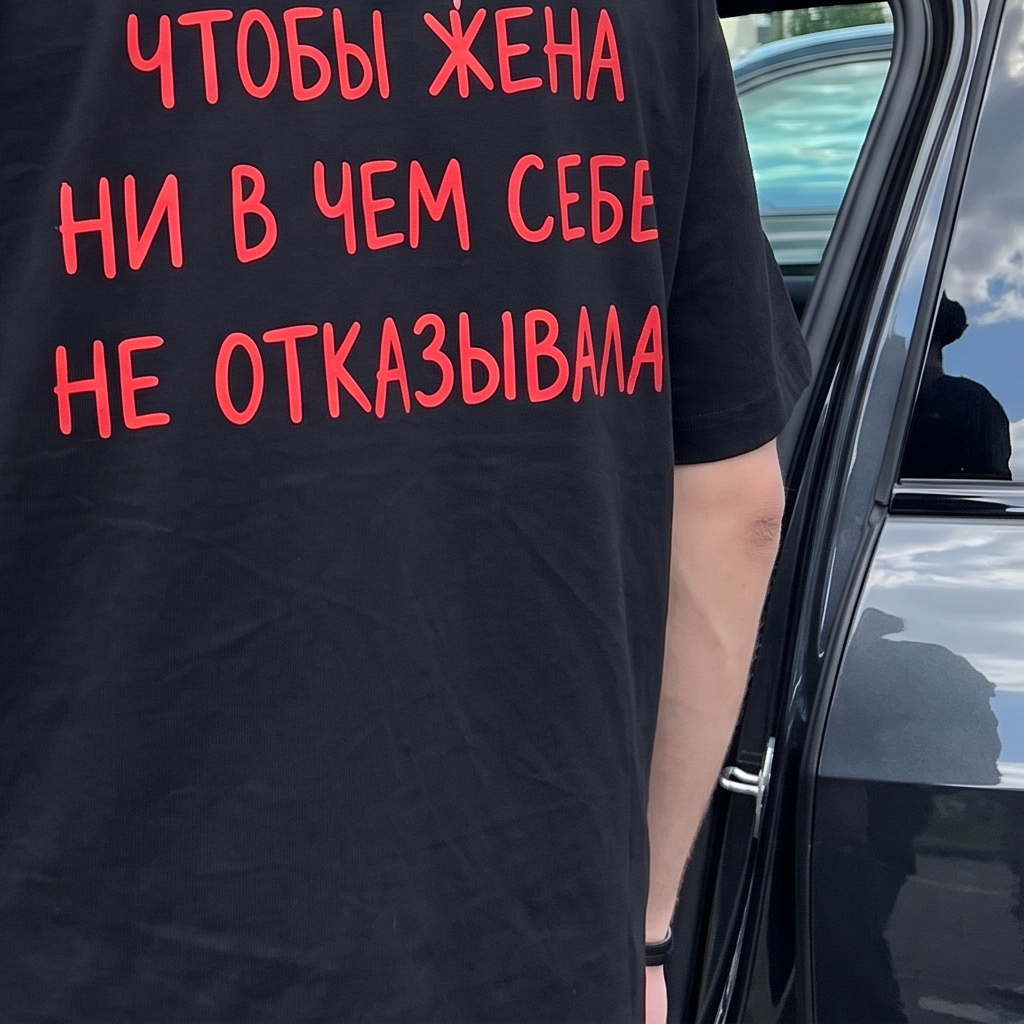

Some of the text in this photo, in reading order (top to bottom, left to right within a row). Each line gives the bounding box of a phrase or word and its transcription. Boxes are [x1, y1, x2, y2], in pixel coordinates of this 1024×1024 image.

[127, 7, 390, 109] ЧТОБЫ
[59, 155, 658, 279] НИ В ЧЕМ СЕБЕ
[54, 306, 663, 439] НЕ ОТКАЗЫВАЛА
